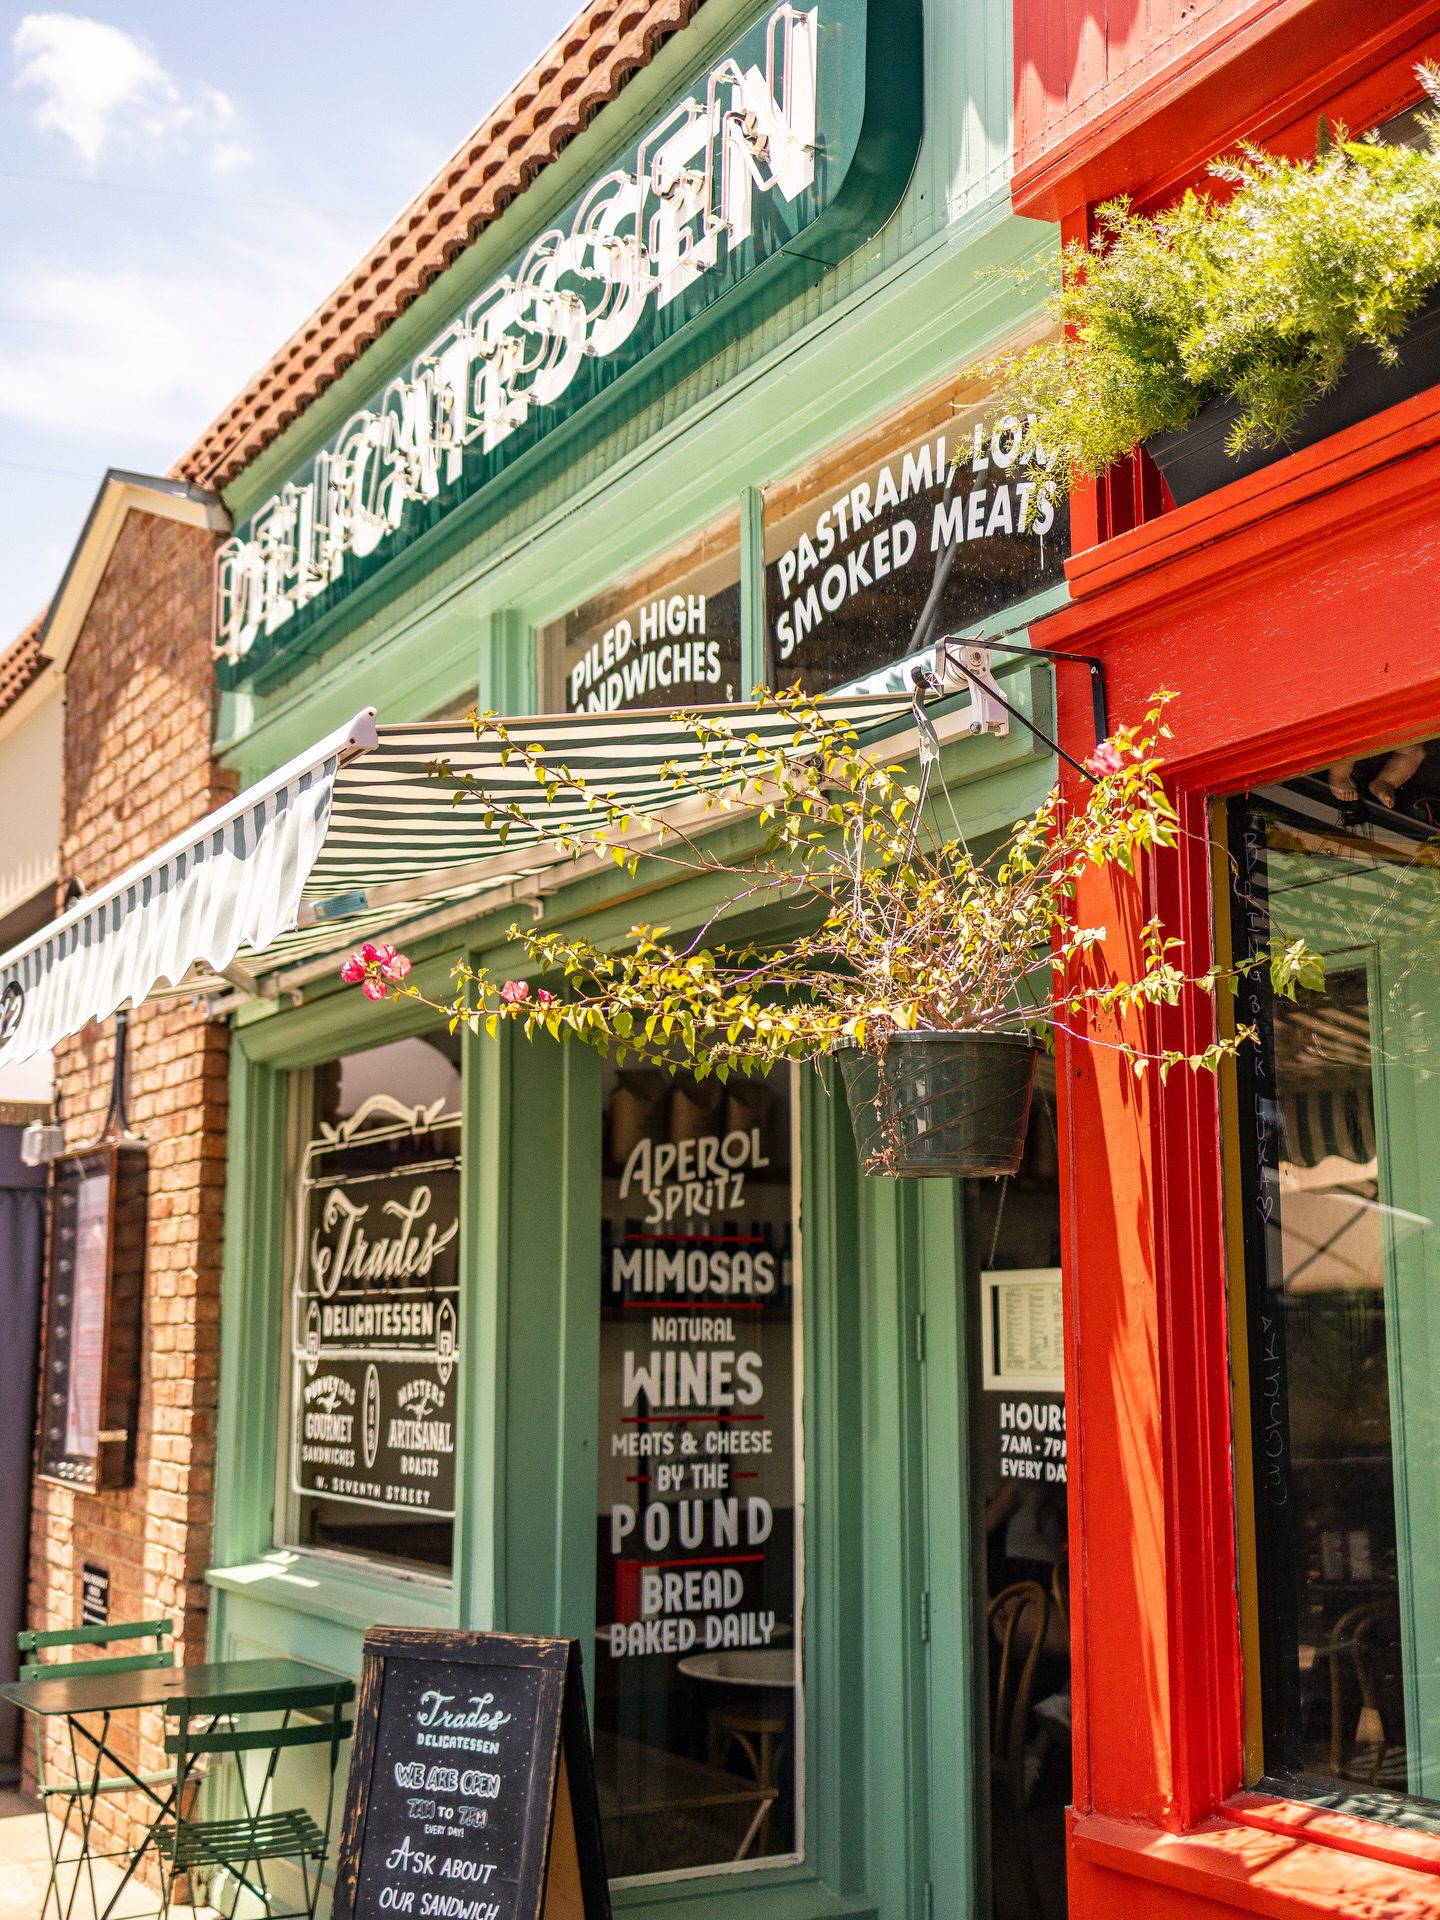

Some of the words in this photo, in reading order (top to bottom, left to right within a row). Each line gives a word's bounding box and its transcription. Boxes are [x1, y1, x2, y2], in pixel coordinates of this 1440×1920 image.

[211, 4, 818, 666] DELICATESSEN
[778, 436, 957, 600] PASTRAMI,
[776, 519, 917, 660] SMOKED
[930, 480, 1055, 552] MEATS
[571, 619, 632, 705] PILED
[640, 595, 706, 645] HIGH
[619, 1127, 770, 1200] APEROL
[311, 1186, 459, 1299] Trades
[612, 1248, 775, 1294] MIMOSAS
[322, 1302, 433, 1336] DELICATESSEN
[652, 1316, 736, 1342] NATURAL
[304, 1375, 356, 1405] PURVEYORS
[397, 1379, 446, 1408] MASTERS
[623, 1350, 764, 1408] WINES
[305, 1412, 354, 1443] GOURMET
[387, 1419, 455, 1453] ARTISANAL
[612, 1432, 674, 1457] MEATS
[680, 1432, 698, 1454] &
[705, 1430, 773, 1454] CHEESE
[1001, 1434, 1032, 1455] 7AM
[302, 1445, 355, 1468] SANDWICHES
[400, 1455, 439, 1478] ROASTS
[1001, 1457, 1043, 1480] EVERY
[1046, 1462, 1068, 1483] DA
[331, 1477, 381, 1498] SEVENTH
[385, 1484, 431, 1505] STREET
[657, 1463, 685, 1492] BY
[692, 1463, 729, 1490] THE
[611, 1496, 774, 1554] POUND
[642, 1568, 744, 1615] BREAD
[610, 1617, 697, 1658] BAKED
[704, 1610, 775, 1649] DAILY
[417, 1689, 512, 1731] Trades
[416, 1732, 500, 1755] DELICATESSEN
[394, 1762, 424, 1789] WE
[425, 1766, 458, 1792] ARE
[460, 1770, 500, 1798] OPEN
[407, 1798, 435, 1819] 7AM
[437, 1806, 454, 1819] TO
[458, 1805, 488, 1829] 7PM
[424, 1824, 446, 1835] EVERY
[447, 1826, 464, 1838] DAY!
[385, 1835, 437, 1875] ASK
[439, 1857, 498, 1884] ABOUT
[379, 1886, 415, 1913] OUR
[420, 1892, 500, 1920] SANDWICH
